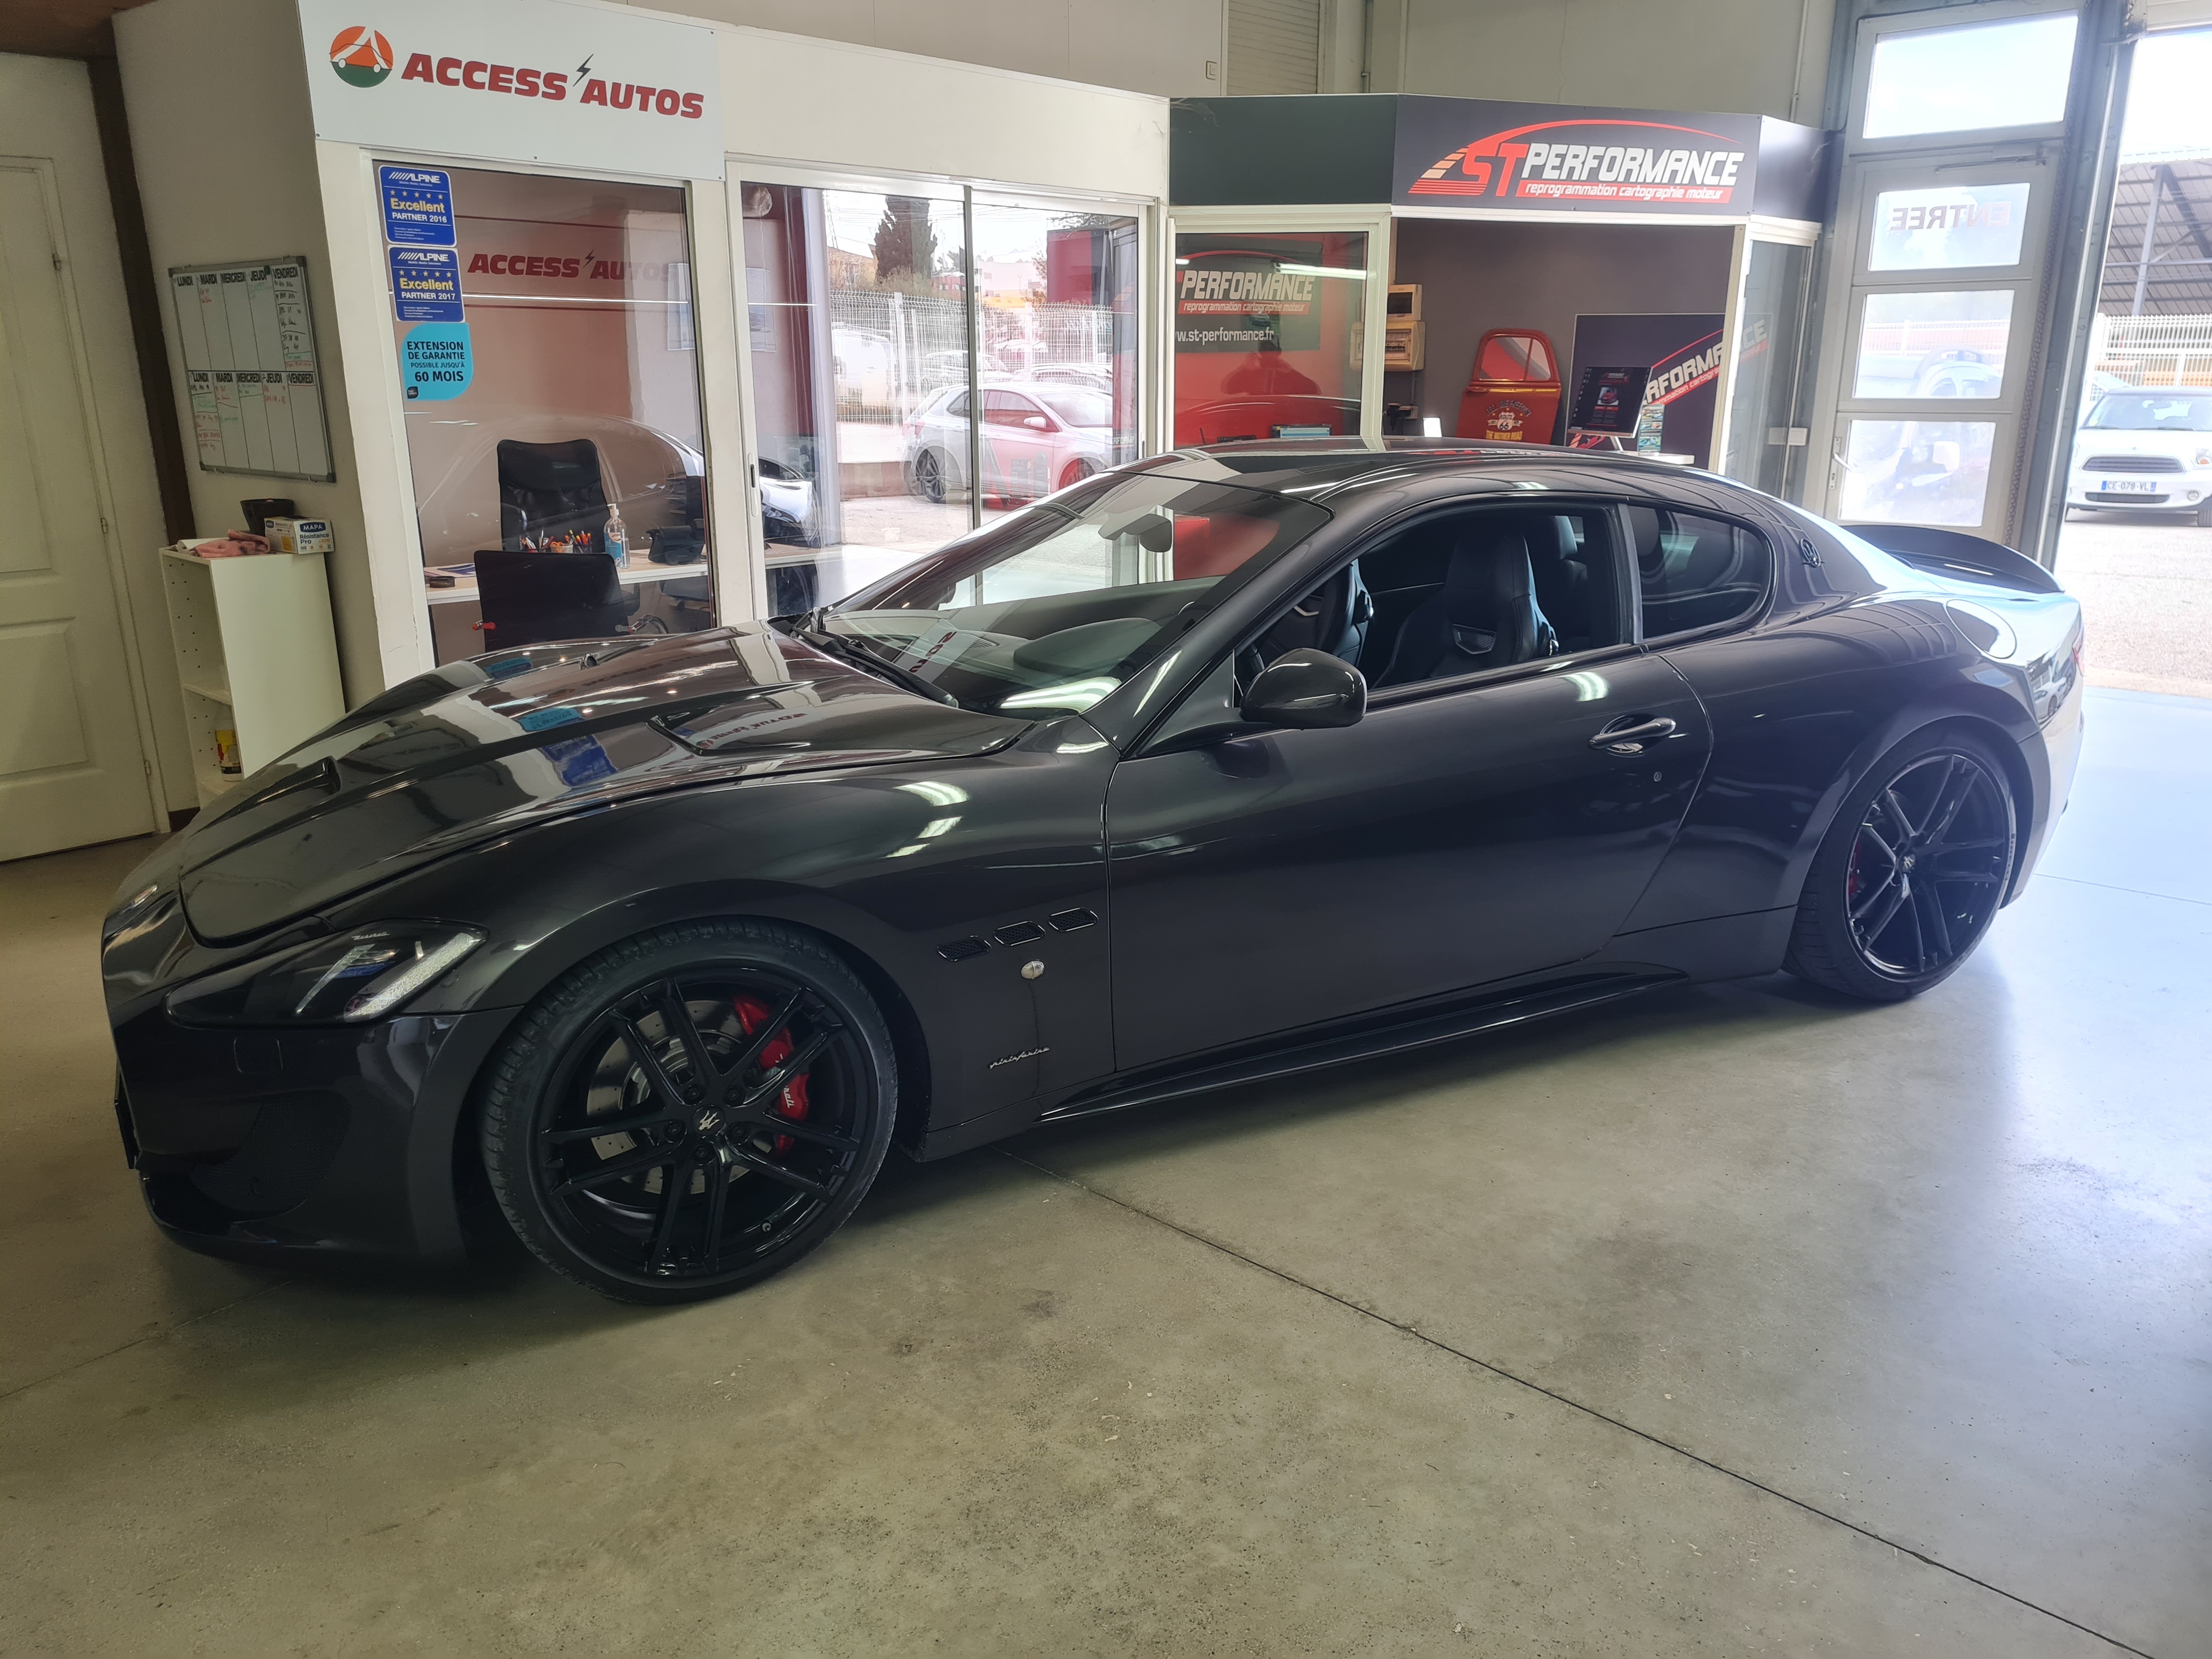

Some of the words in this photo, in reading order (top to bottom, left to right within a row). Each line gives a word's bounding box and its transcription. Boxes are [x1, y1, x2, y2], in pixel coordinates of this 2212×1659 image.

[401, 53, 568, 100] ACCESS
[579, 79, 704, 119] AUTOS
[1521, 143, 1745, 185] PERFORMANCE
[404, 172, 441, 184] ALPINE
[1526, 183, 1617, 198] reprogrammation
[1618, 185, 1684, 201] cartographie
[1686, 187, 1723, 199] moteur
[391, 198, 445, 213] Excellent
[392, 212, 427, 222] PARTNER
[414, 252, 450, 262] ALPINE
[274, 267, 299, 279] VENDREDI
[467, 253, 580, 278] ACCESS
[590, 260, 675, 282] AUTOS
[177, 276, 194, 286] LUNDI
[200, 274, 218, 284] MARDI
[221, 272, 246, 283] MERCREDI
[251, 270, 267, 281] JEUDI
[400, 278, 453, 290] Excellent
[1180, 270, 1316, 301] PERFORMANCE
[1183, 302, 1242, 313] reprogrammation
[1243, 303, 1282, 313] cartographie
[407, 341, 464, 350] EXTENSION
[193, 373, 209, 382] LUNDI
[216, 373, 233, 382] MARDI
[237, 373, 261, 382] MERCREDI
[266, 373, 283, 383] JEUDI
[289, 373, 314, 384] VENDREDI
[415, 371, 429, 381] 60
[433, 371, 464, 381] MOIS
